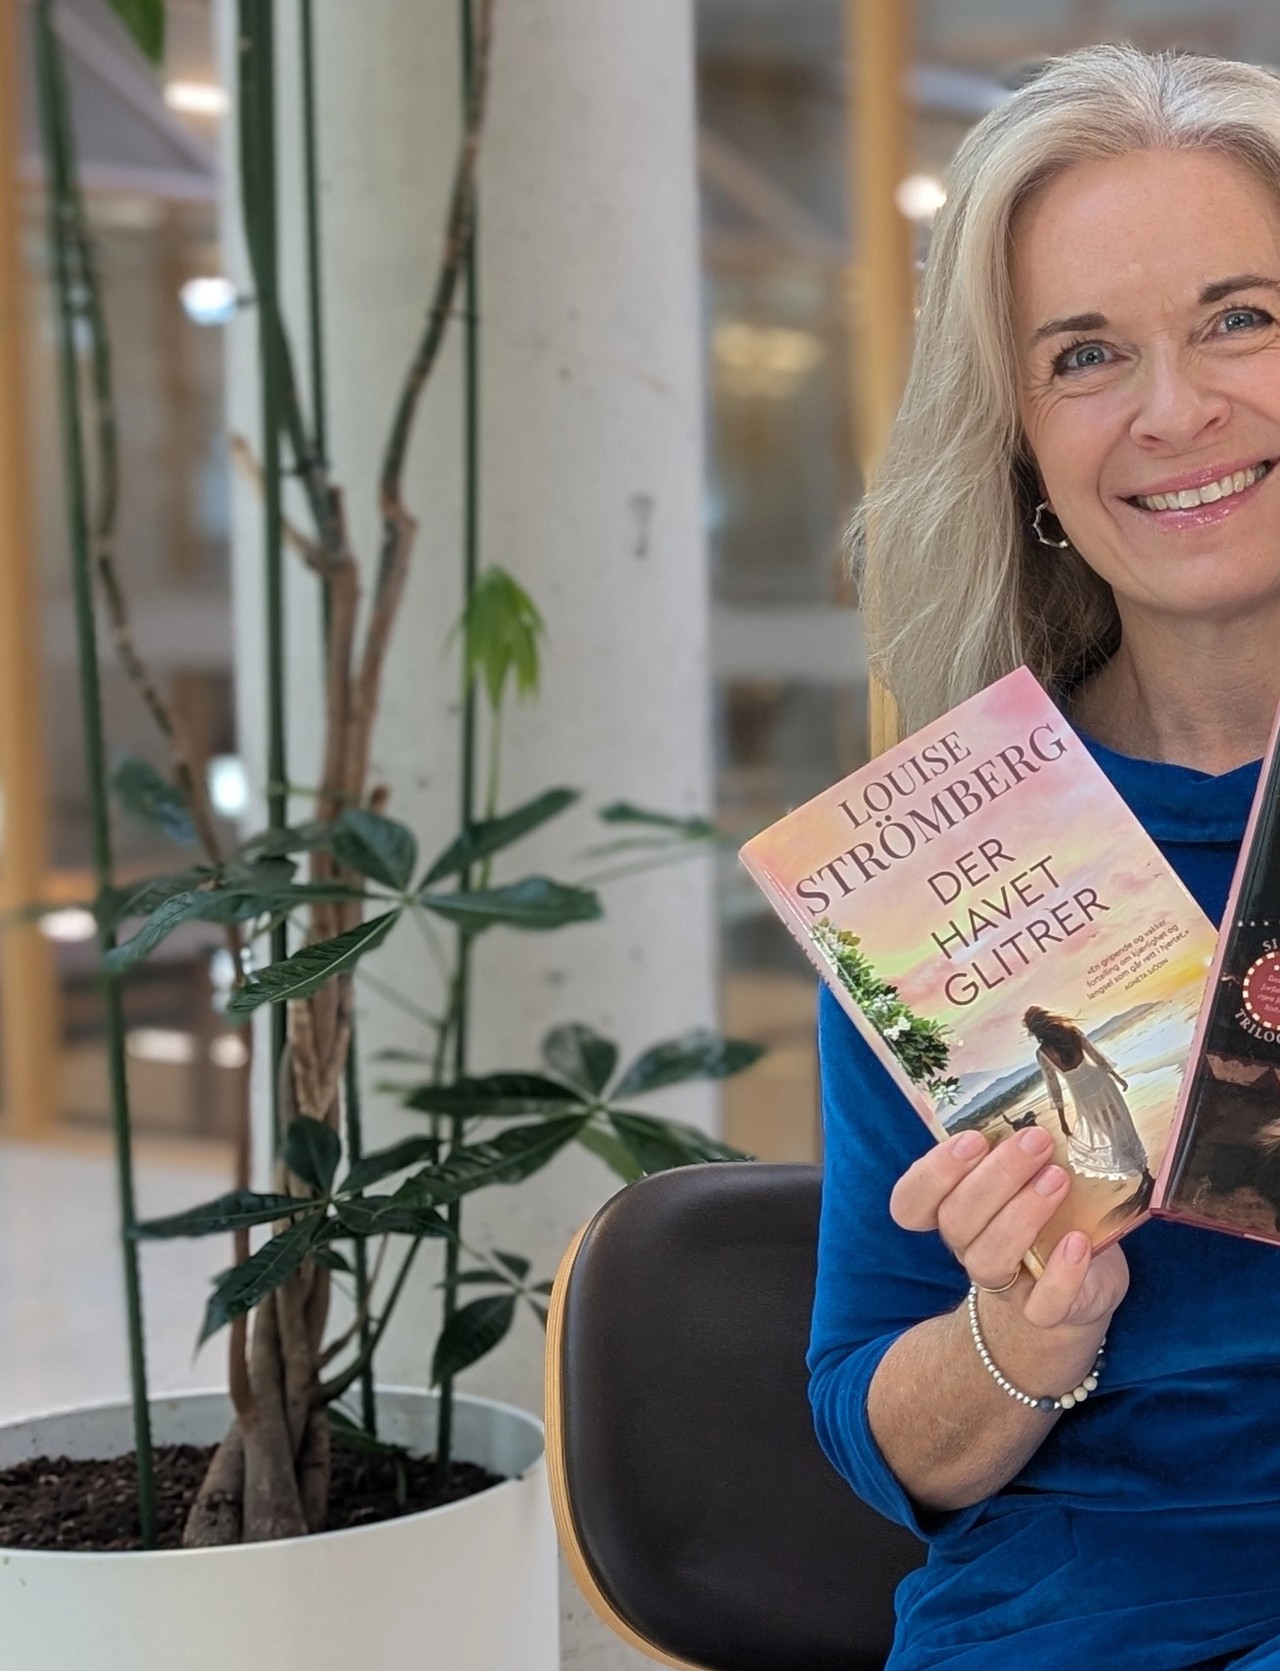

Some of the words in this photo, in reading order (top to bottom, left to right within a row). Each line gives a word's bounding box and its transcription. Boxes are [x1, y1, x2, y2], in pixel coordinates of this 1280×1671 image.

[838, 730, 972, 830] LOUISE
[795, 722, 1068, 916] STRÖMBERG
[927, 838, 1016, 906] DER
[930, 855, 1059, 959] HAVET
[944, 887, 1111, 1006] GLITRER
[1086, 964, 1119, 987] fortelling
[1120, 955, 1132, 966] om
[1131, 931, 1167, 957] kjærlighet
[1168, 924, 1179, 934] og
[1086, 978, 1114, 1000] lengsel
[1114, 969, 1130, 983] som
[1130, 961, 1142, 973] går
[1143, 951, 1157, 963] rett
[1101, 942, 1133, 967] gripende
[1133, 935, 1144, 944] og
[1144, 920, 1167, 937] vakker
[1124, 973, 1148, 991] AGNETA
